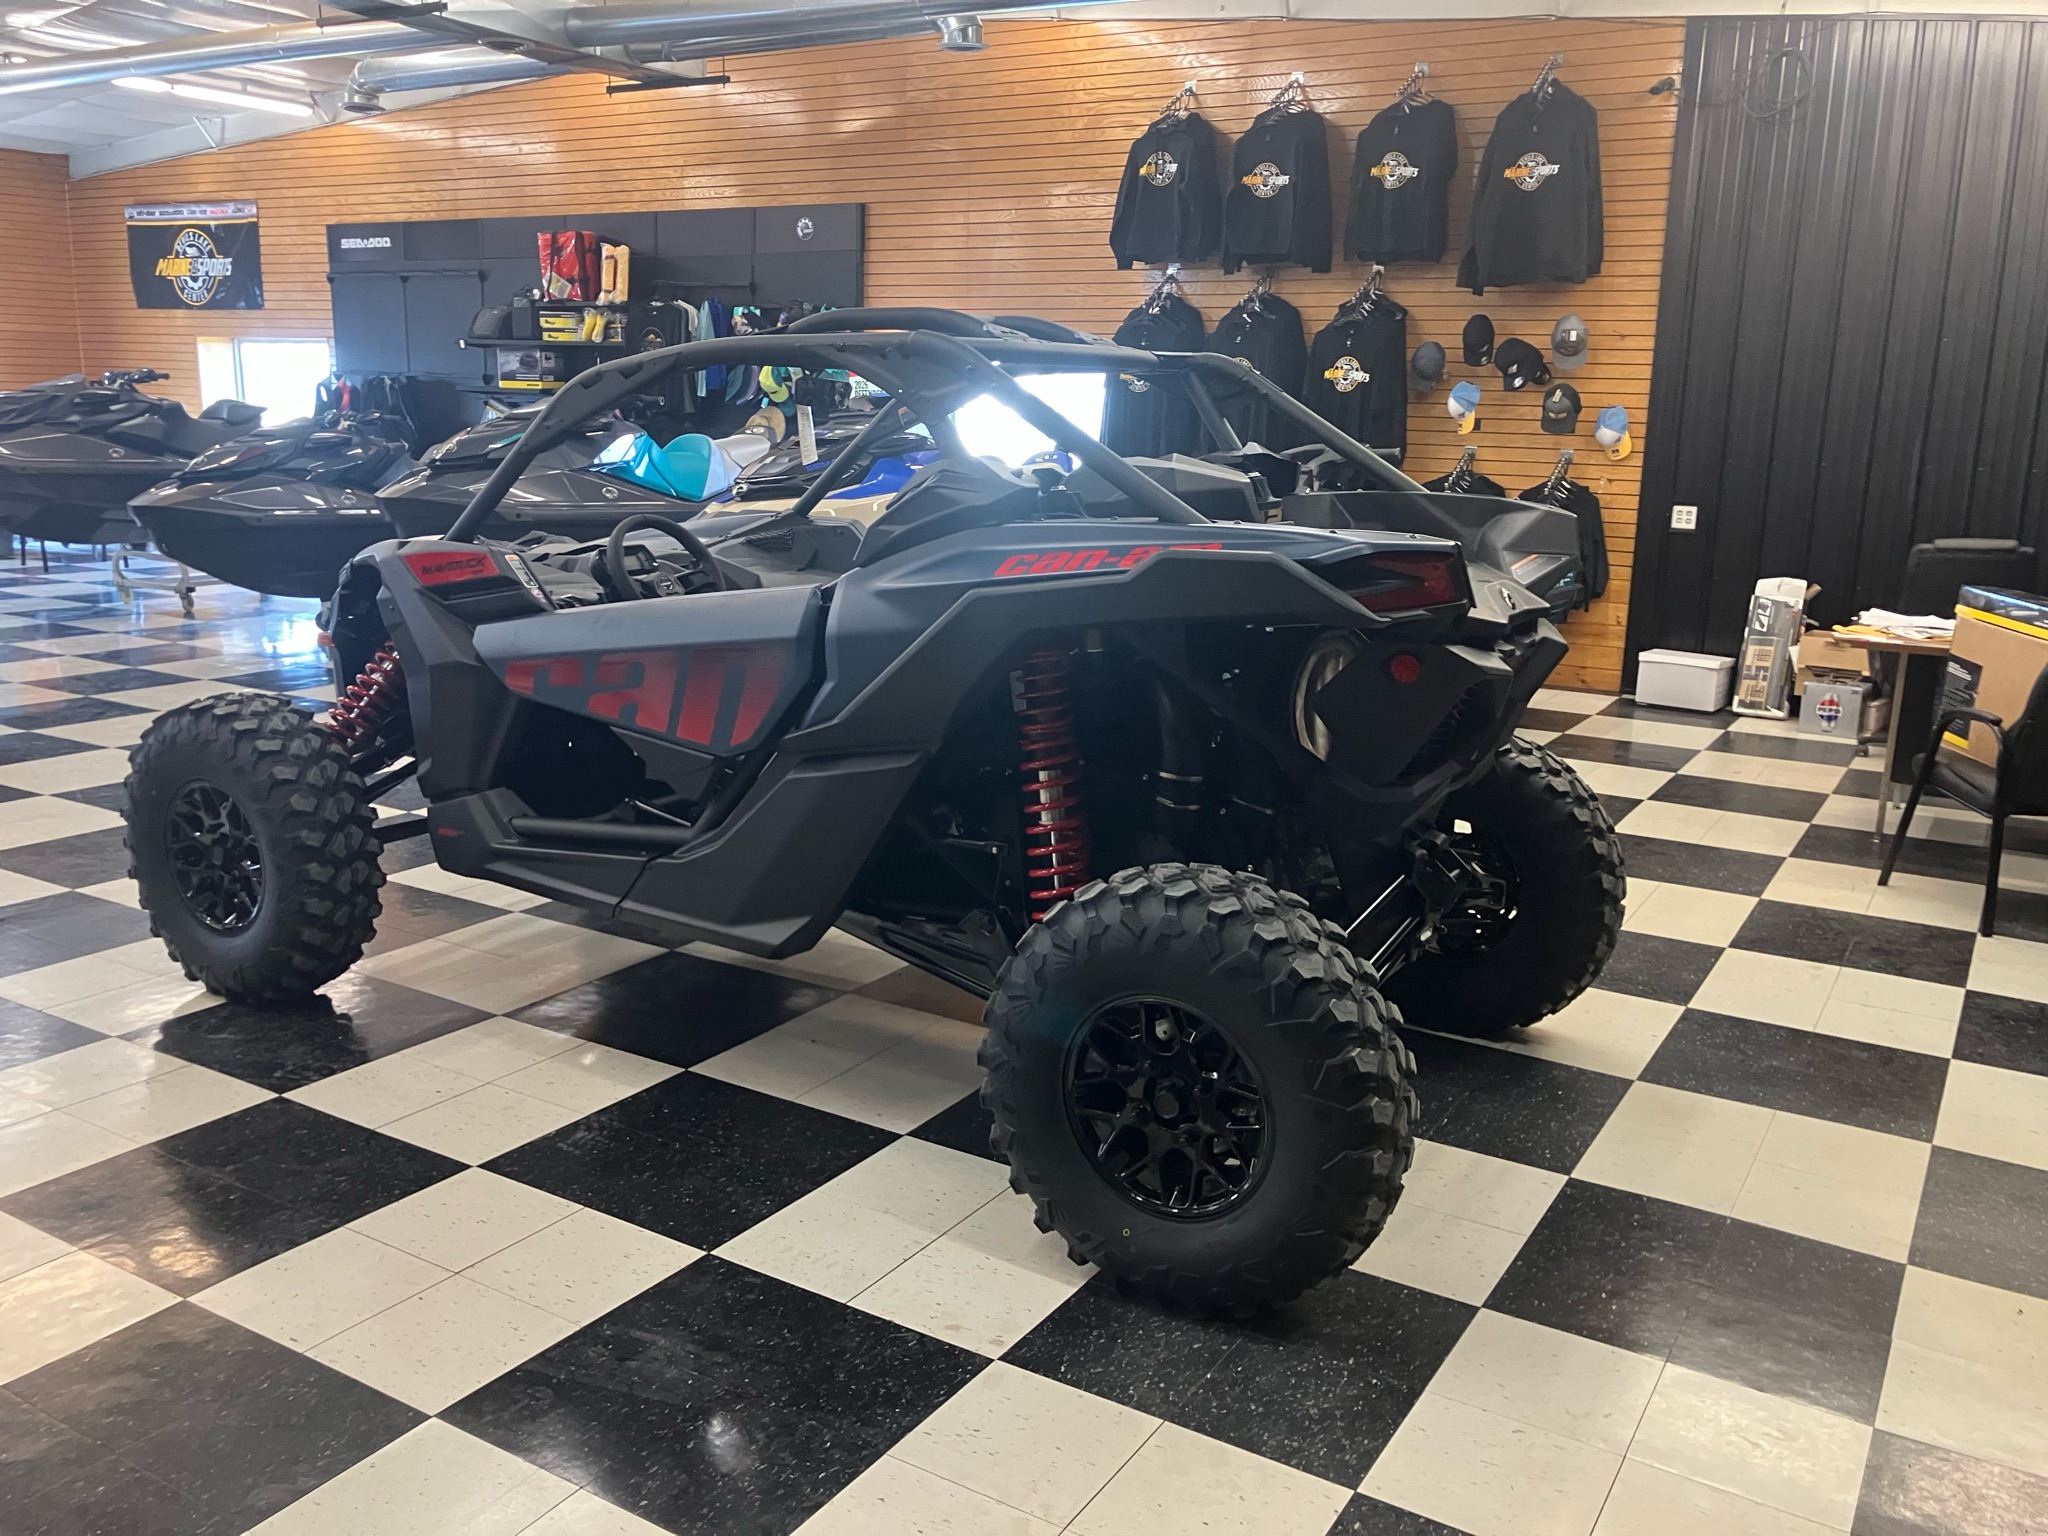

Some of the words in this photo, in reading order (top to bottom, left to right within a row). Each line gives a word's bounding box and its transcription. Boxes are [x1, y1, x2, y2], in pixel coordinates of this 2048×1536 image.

[195, 233, 212, 252] LAKE
[155, 258, 191, 276] MARINE
[197, 257, 233, 276] SPORTS
[183, 289, 209, 302] CENTER
[854, 380, 869, 390] 2026
[421, 557, 486, 576] MAVERICK
